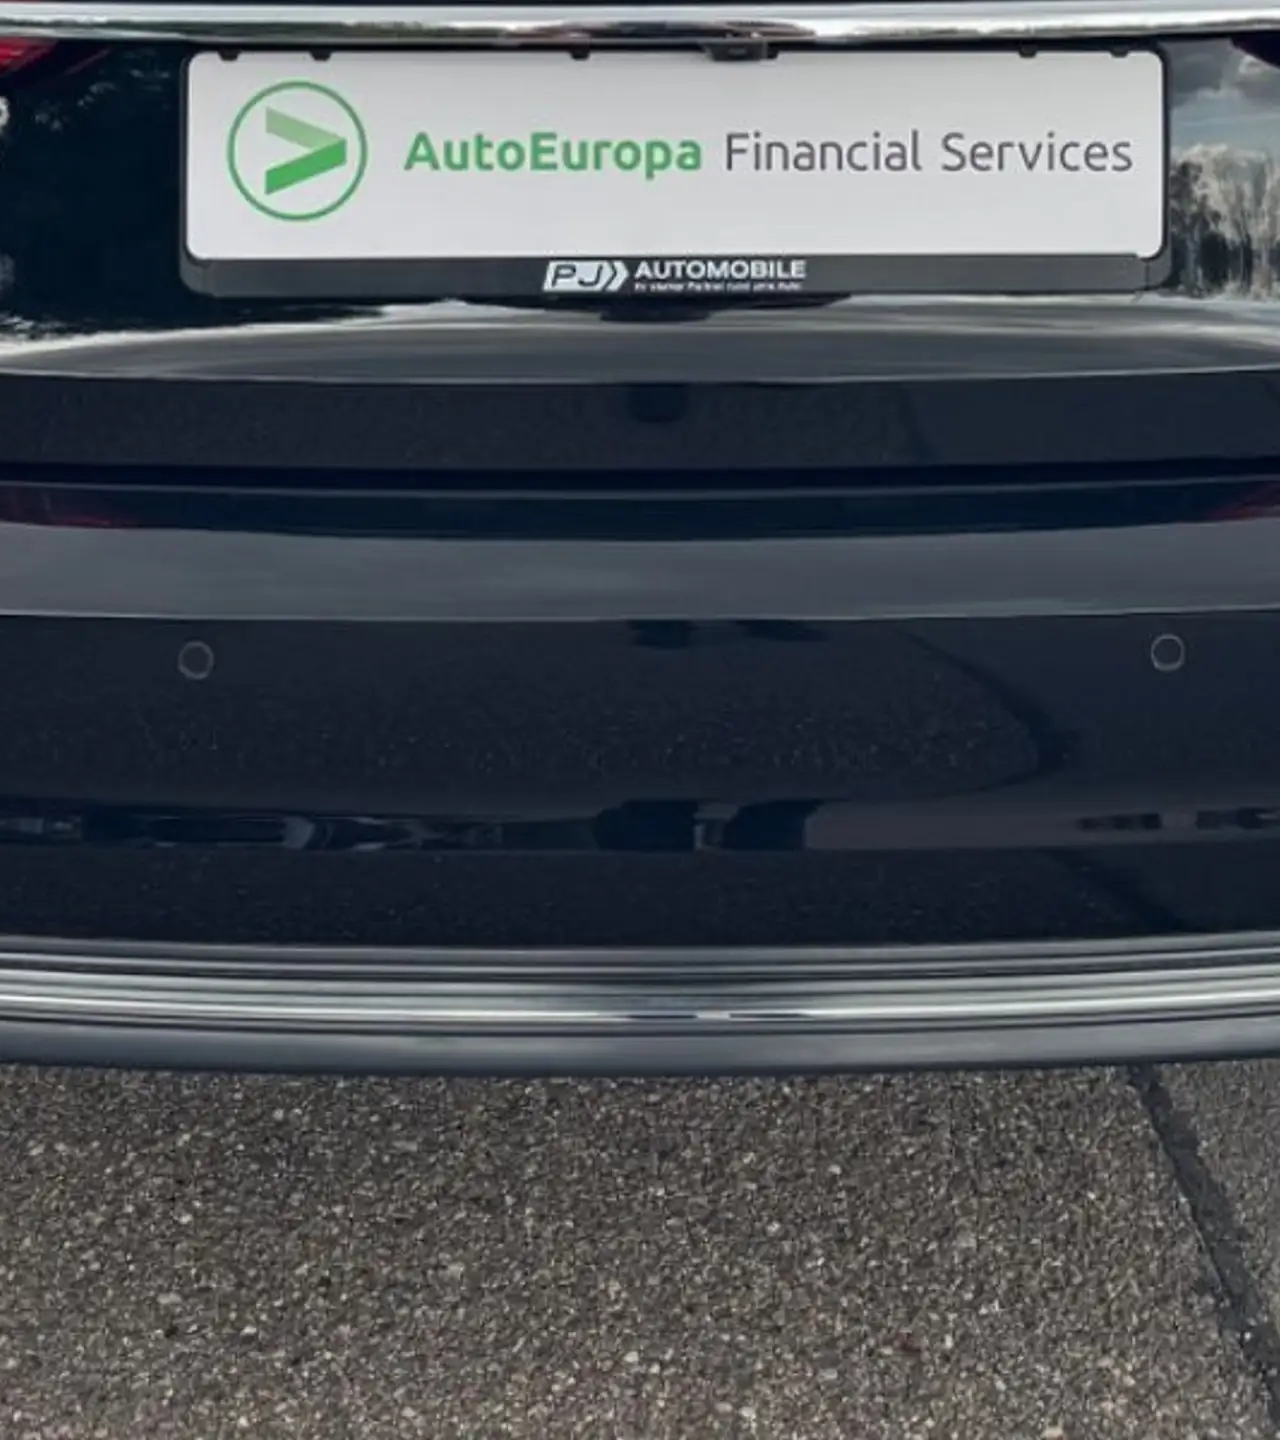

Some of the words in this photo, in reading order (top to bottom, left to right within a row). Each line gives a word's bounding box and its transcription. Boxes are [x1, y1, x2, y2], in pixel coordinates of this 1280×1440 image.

[403, 130, 702, 180] AutoEuropa
[726, 129, 923, 172] Financial
[941, 130, 1133, 172] Services
[634, 260, 807, 279] AUTOMOBILE
